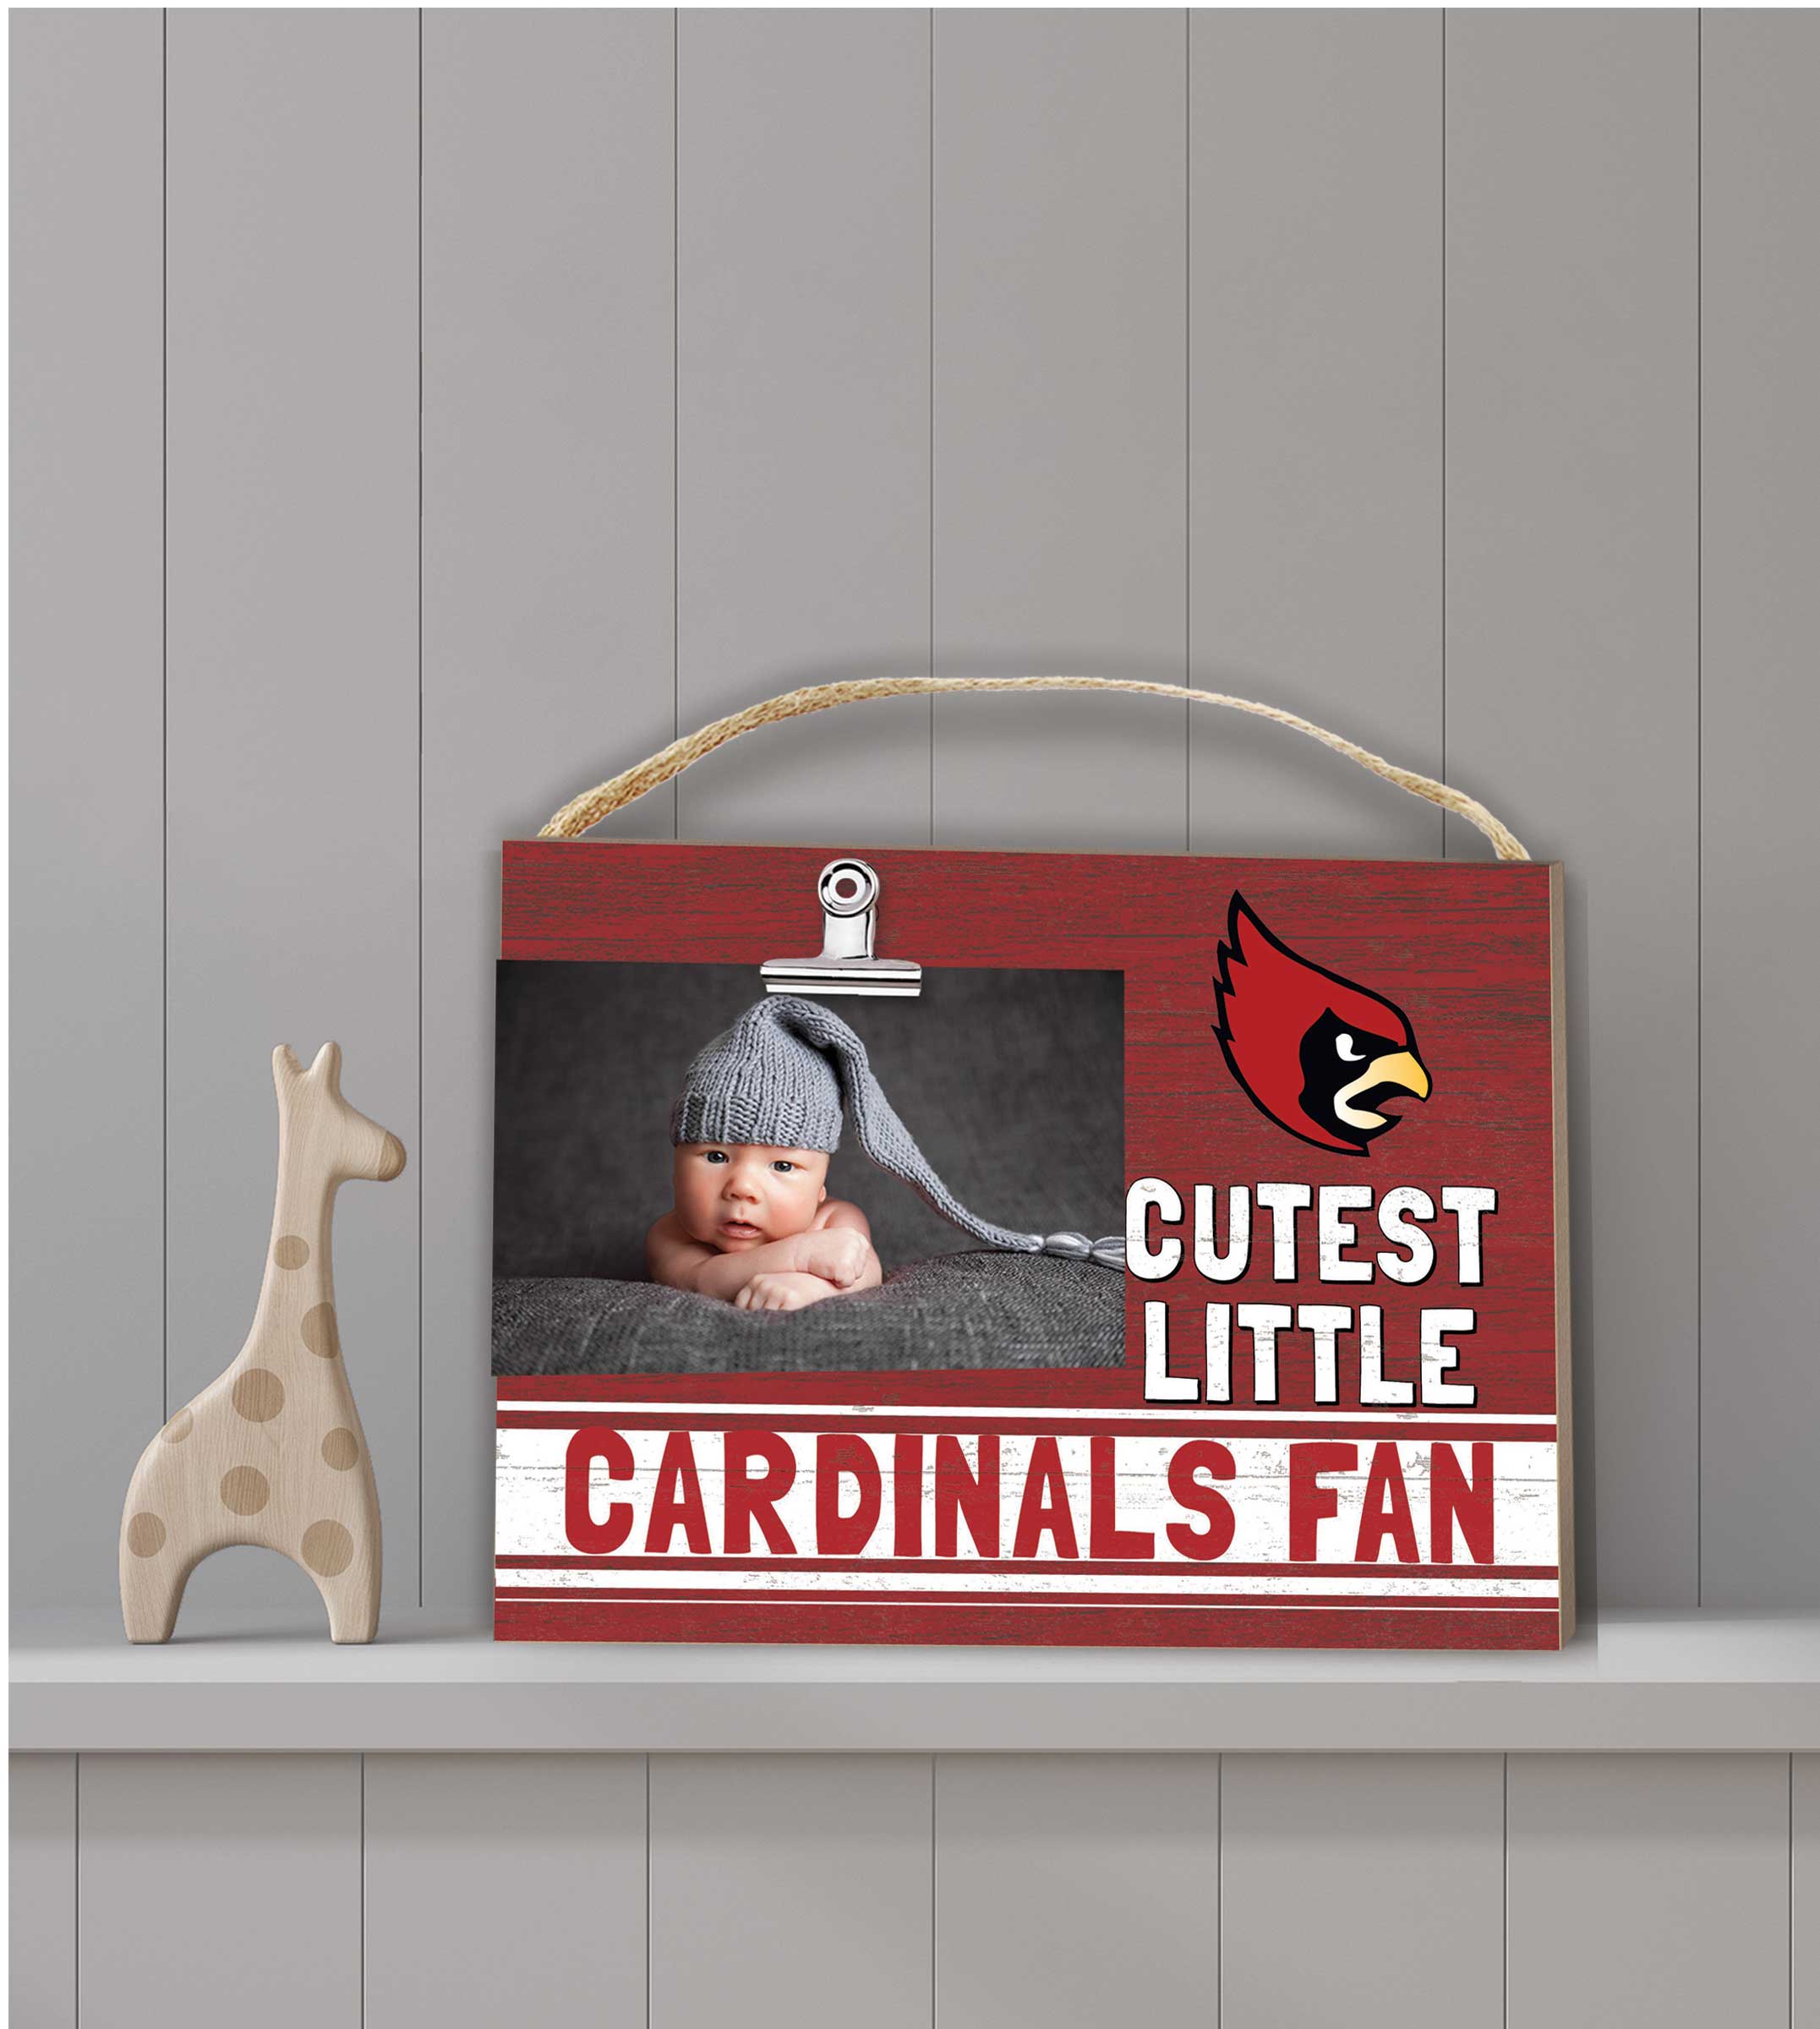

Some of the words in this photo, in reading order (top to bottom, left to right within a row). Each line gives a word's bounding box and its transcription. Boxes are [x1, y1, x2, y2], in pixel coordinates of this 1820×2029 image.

[1125, 1177, 1498, 1286] CUTEST
[1144, 1300, 1478, 1407] LITTLE
[564, 1426, 1238, 1561] CARDINALS
[1287, 1441, 1495, 1564] FAN
